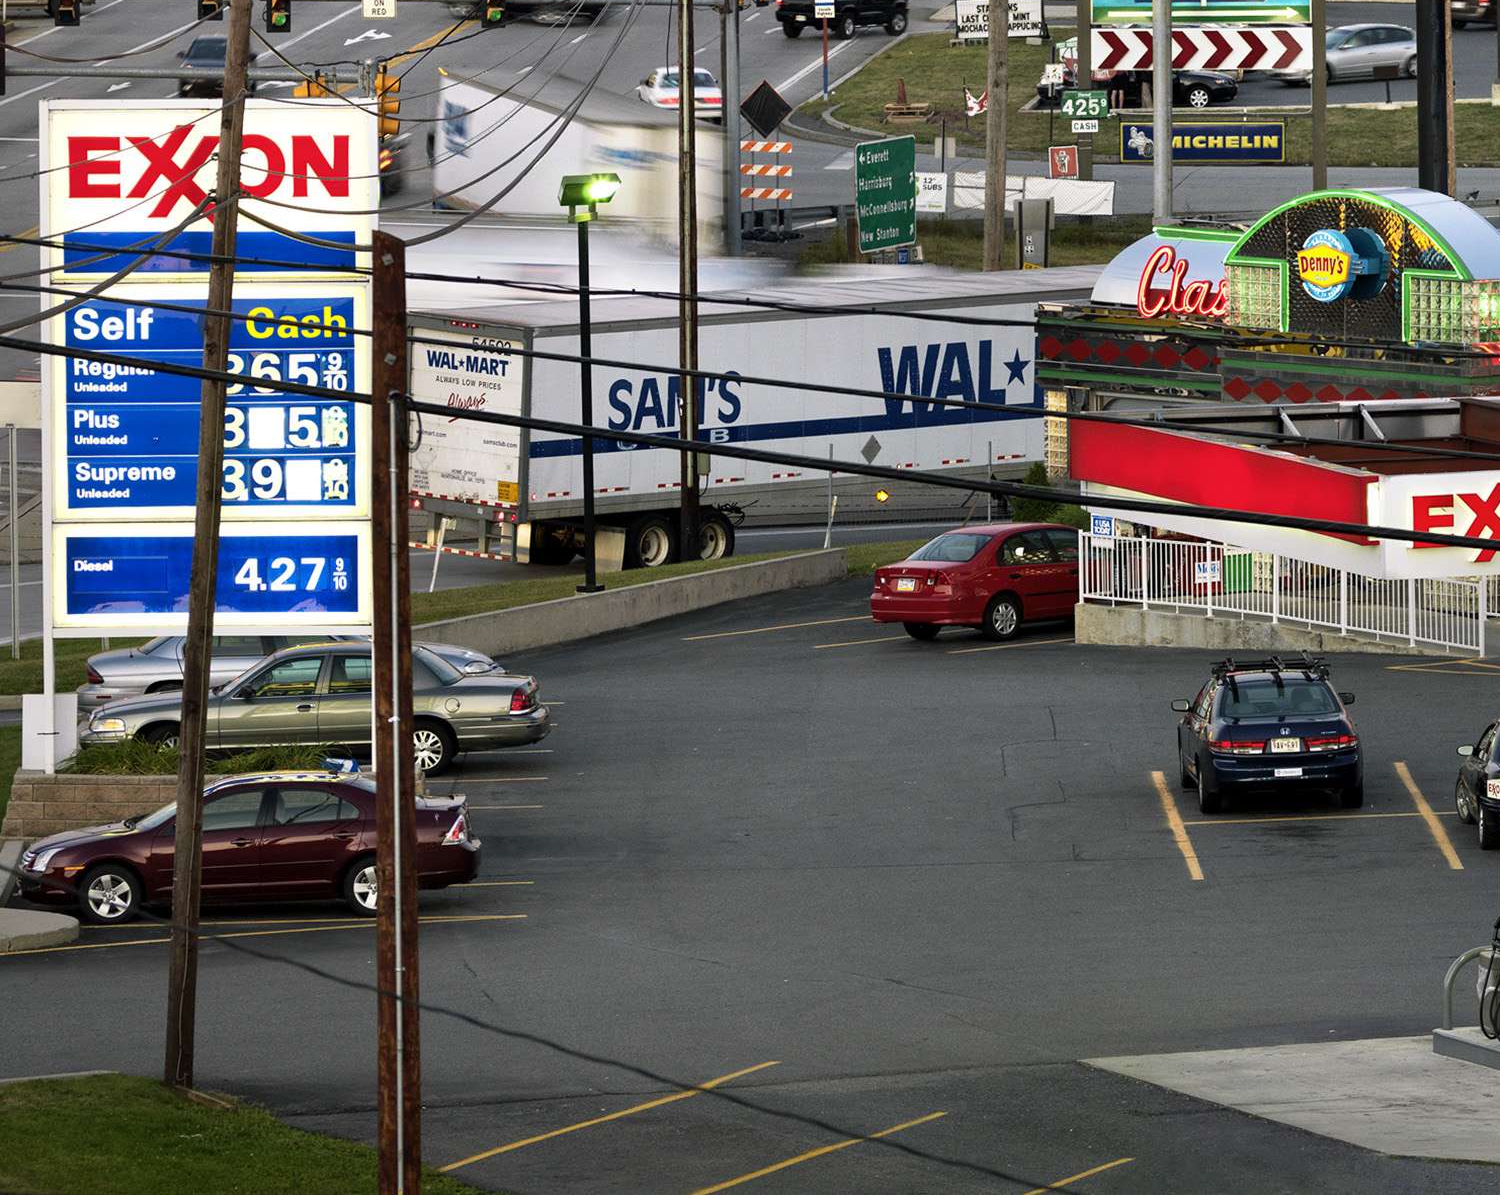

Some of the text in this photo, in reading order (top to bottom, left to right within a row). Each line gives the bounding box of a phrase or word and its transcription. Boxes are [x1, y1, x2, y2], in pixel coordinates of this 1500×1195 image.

[371, 7, 387, 16] RED
[961, 12, 1031, 24] LAST MINT
[1073, 121, 1097, 131] CASH
[866, 150, 889, 164] Everett
[67, 123, 350, 224] EXXON
[858, 175, 893, 192] Harrisburg
[922, 183, 943, 191] SUBS
[859, 198, 908, 216] McConnellsburg
[860, 226, 900, 242] New Stanton
[1299, 255, 1344, 276] Denny's
[73, 306, 347, 342] Self Cash
[435, 375, 502, 391] ALWAYS LOW PRICES
[877, 338, 1006, 416] WAL
[73, 381, 128, 393] Unleaded
[73, 409, 120, 429] Plus
[74, 434, 128, 446] Unleaded
[482, 439, 518, 449] samsclub.com
[75, 462, 176, 483] Supreme
[76, 486, 130, 500] Unleaded
[73, 556, 326, 593] Diesel 4.27
